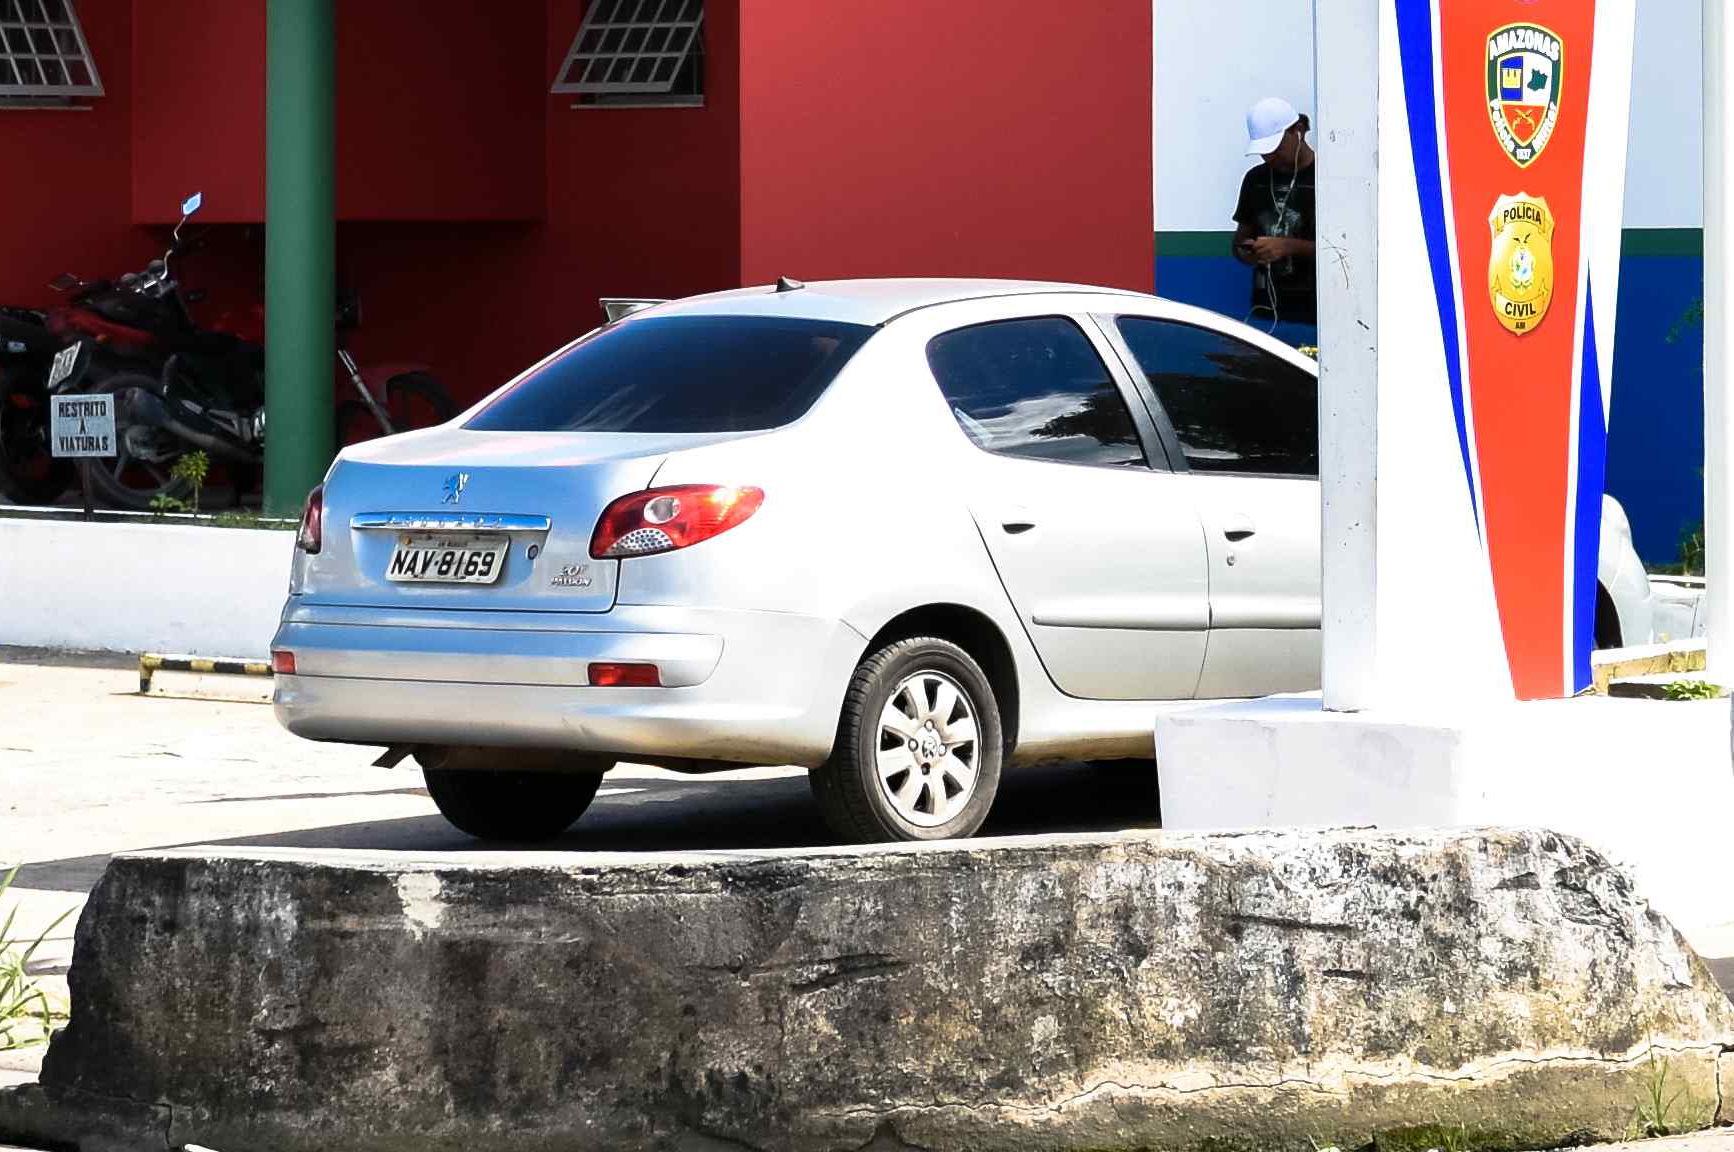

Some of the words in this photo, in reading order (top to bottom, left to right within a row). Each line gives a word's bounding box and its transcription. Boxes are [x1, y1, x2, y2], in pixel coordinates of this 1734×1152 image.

[1489, 29, 1560, 61] AMAZONAS
[1503, 202, 1542, 225] POLÍCIA
[1504, 301, 1537, 317] CIVIL
[58, 401, 107, 417] RESTRITO
[58, 436, 108, 452] VIATURAS
